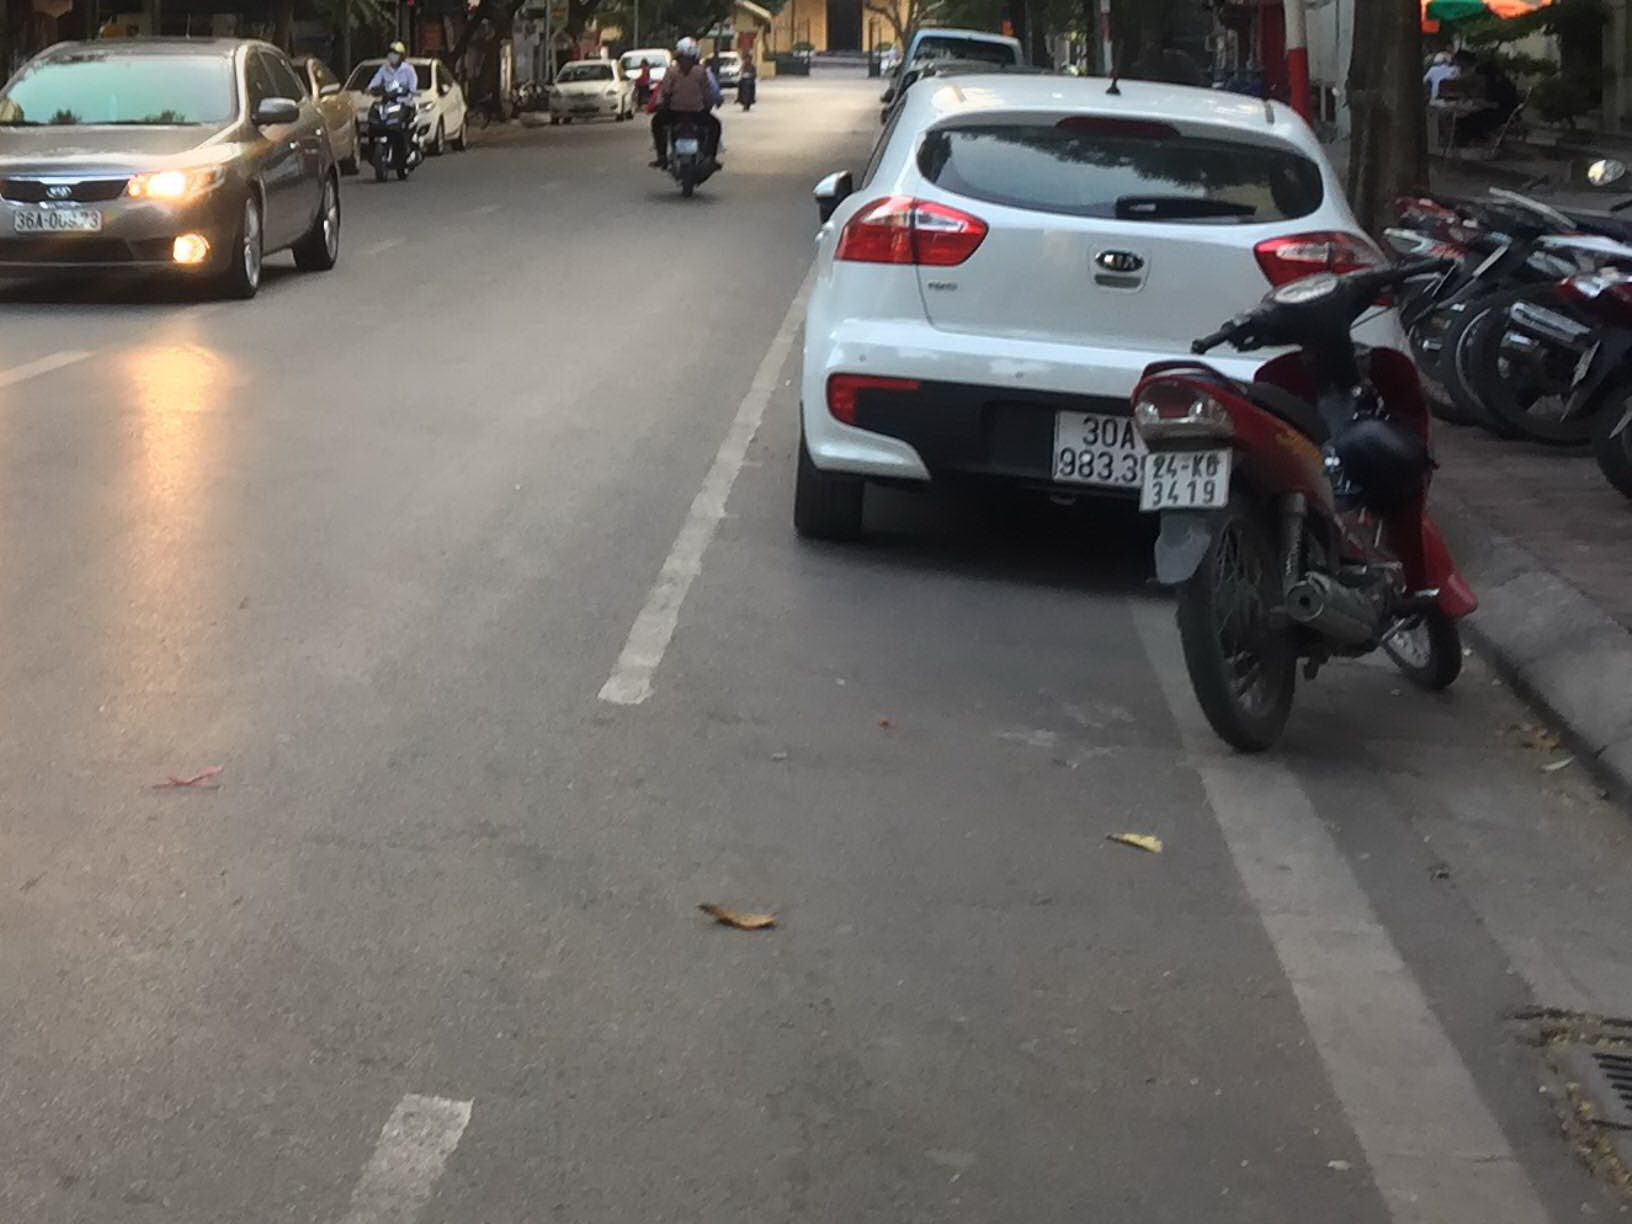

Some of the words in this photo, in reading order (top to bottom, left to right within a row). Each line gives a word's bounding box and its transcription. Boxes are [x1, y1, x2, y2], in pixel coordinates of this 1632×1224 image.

[1082, 416, 1136, 450] 30A
[1058, 447, 1147, 483] 983.3
[1152, 480, 1216, 506] 3419
